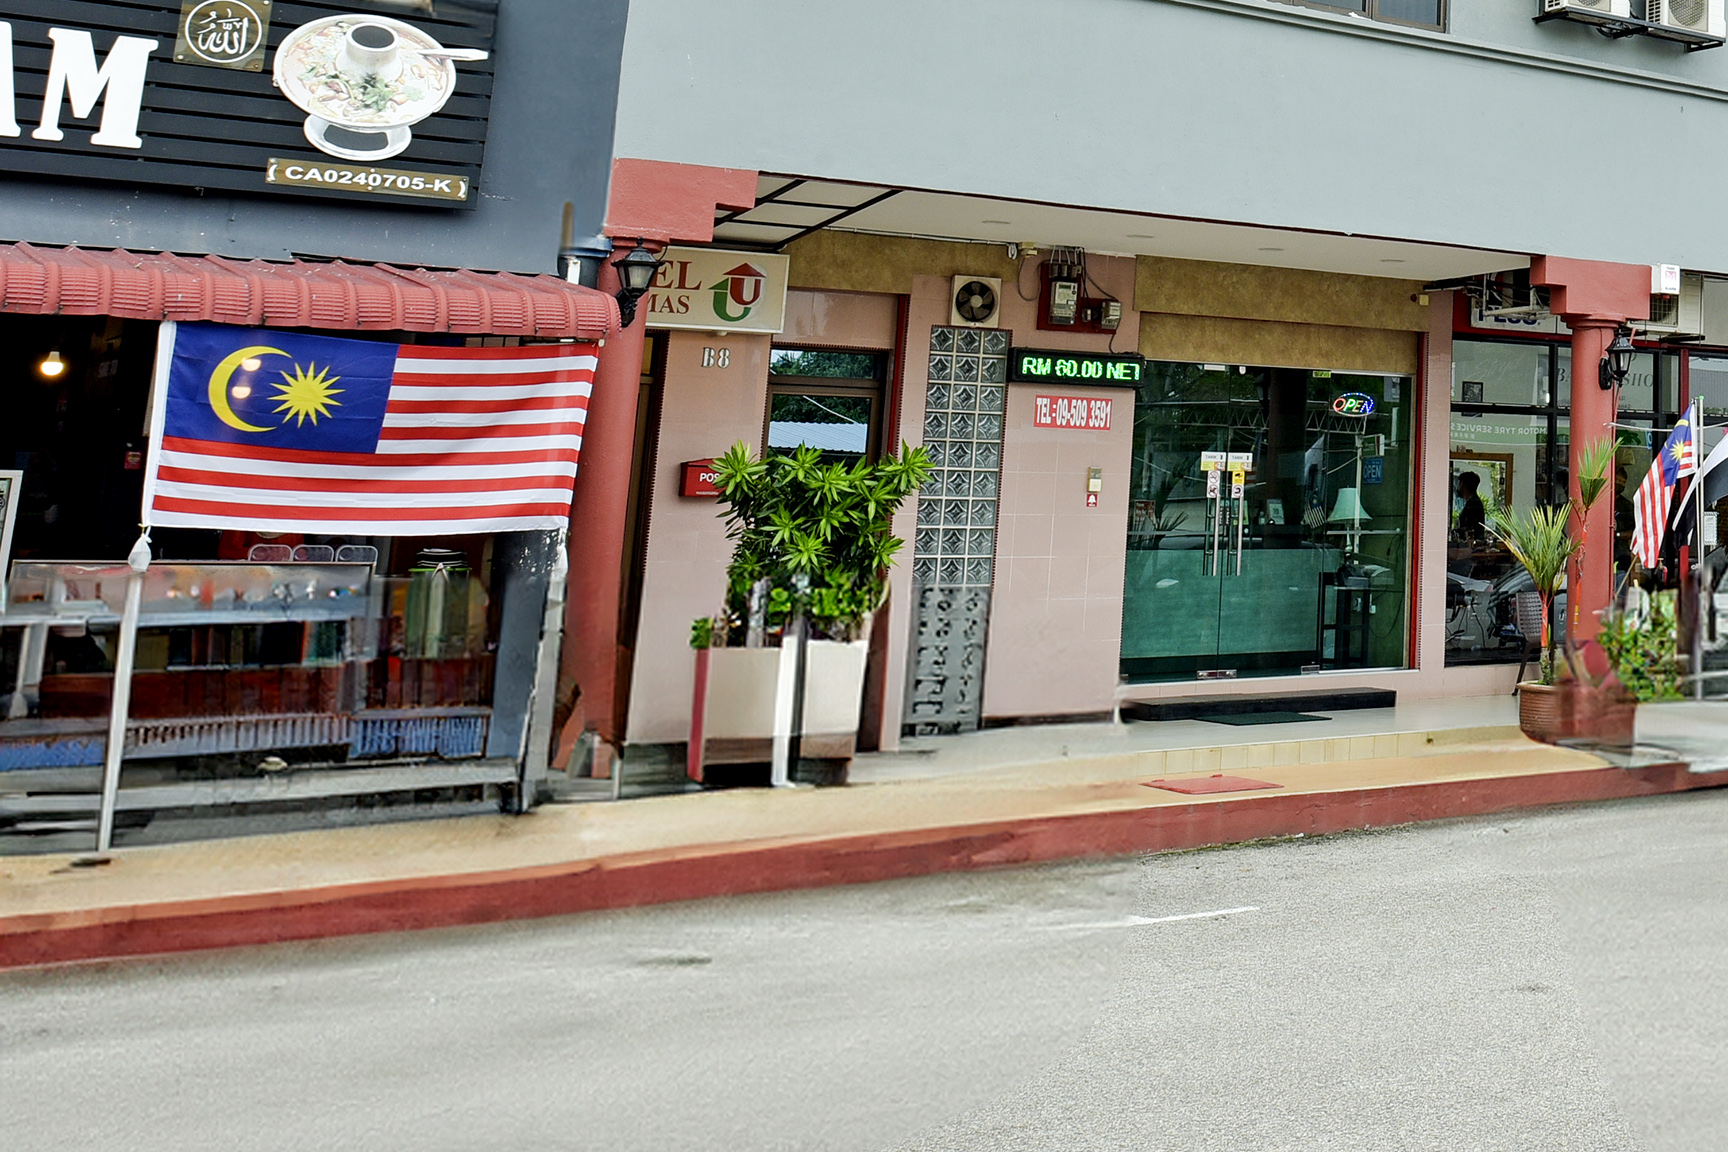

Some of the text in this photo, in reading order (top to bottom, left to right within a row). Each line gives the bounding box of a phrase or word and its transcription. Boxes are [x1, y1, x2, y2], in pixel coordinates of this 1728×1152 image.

[701, 346, 731, 369] B8
[1022, 356, 1051, 375] RM
[1333, 398, 1374, 413] OPEN
